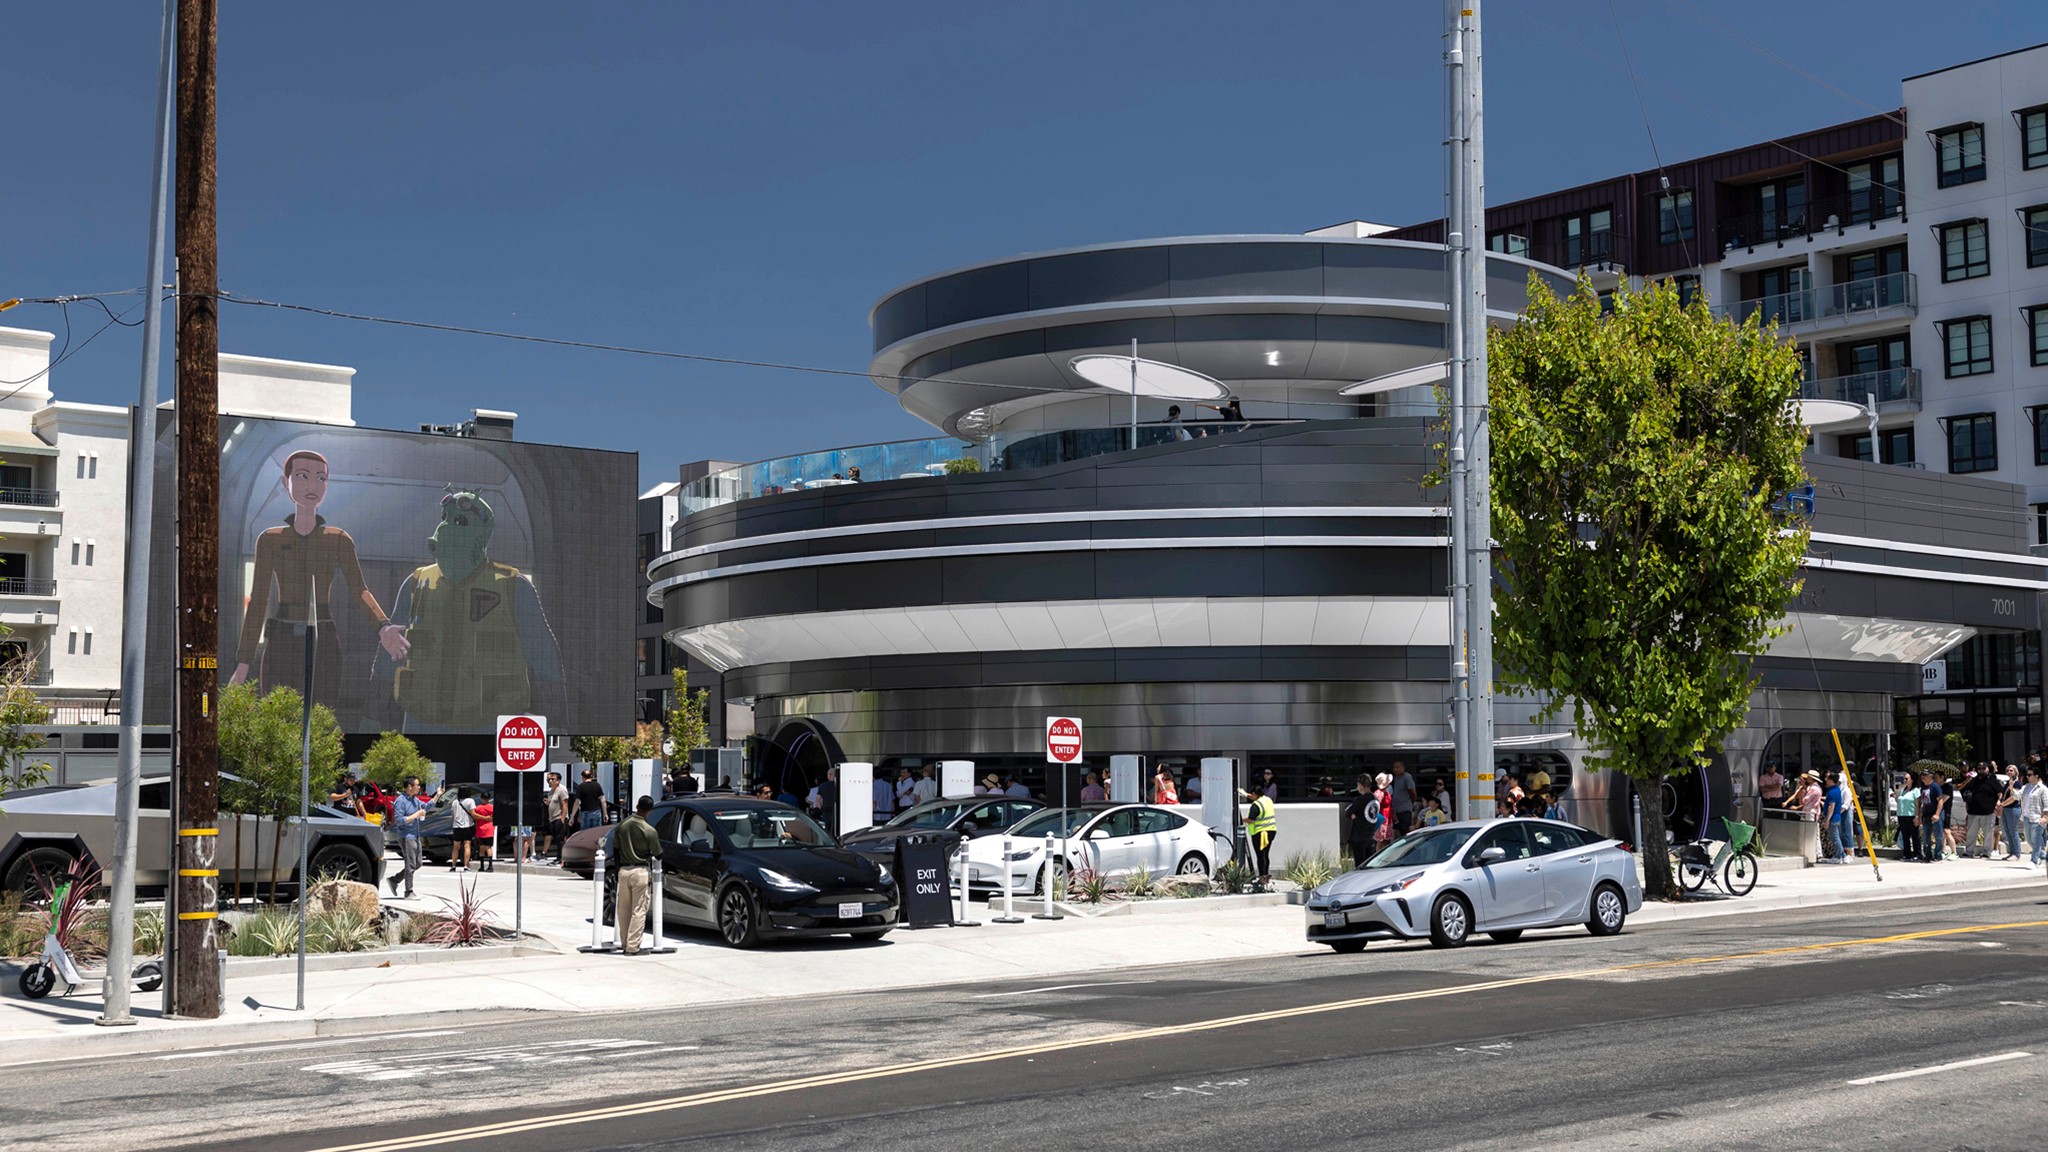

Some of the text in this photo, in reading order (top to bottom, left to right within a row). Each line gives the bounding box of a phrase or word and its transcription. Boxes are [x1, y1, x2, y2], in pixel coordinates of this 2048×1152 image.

[1991, 598, 2016, 616] 7001
[1924, 721, 1943, 730] 6933
[504, 727, 539, 736] DO NOT
[1052, 726, 1077, 735] DO NOT
[1055, 746, 1075, 754] ENTER
[508, 751, 535, 760] ENTER
[917, 868, 937, 880] EXIT
[916, 883, 941, 895] ONLY
